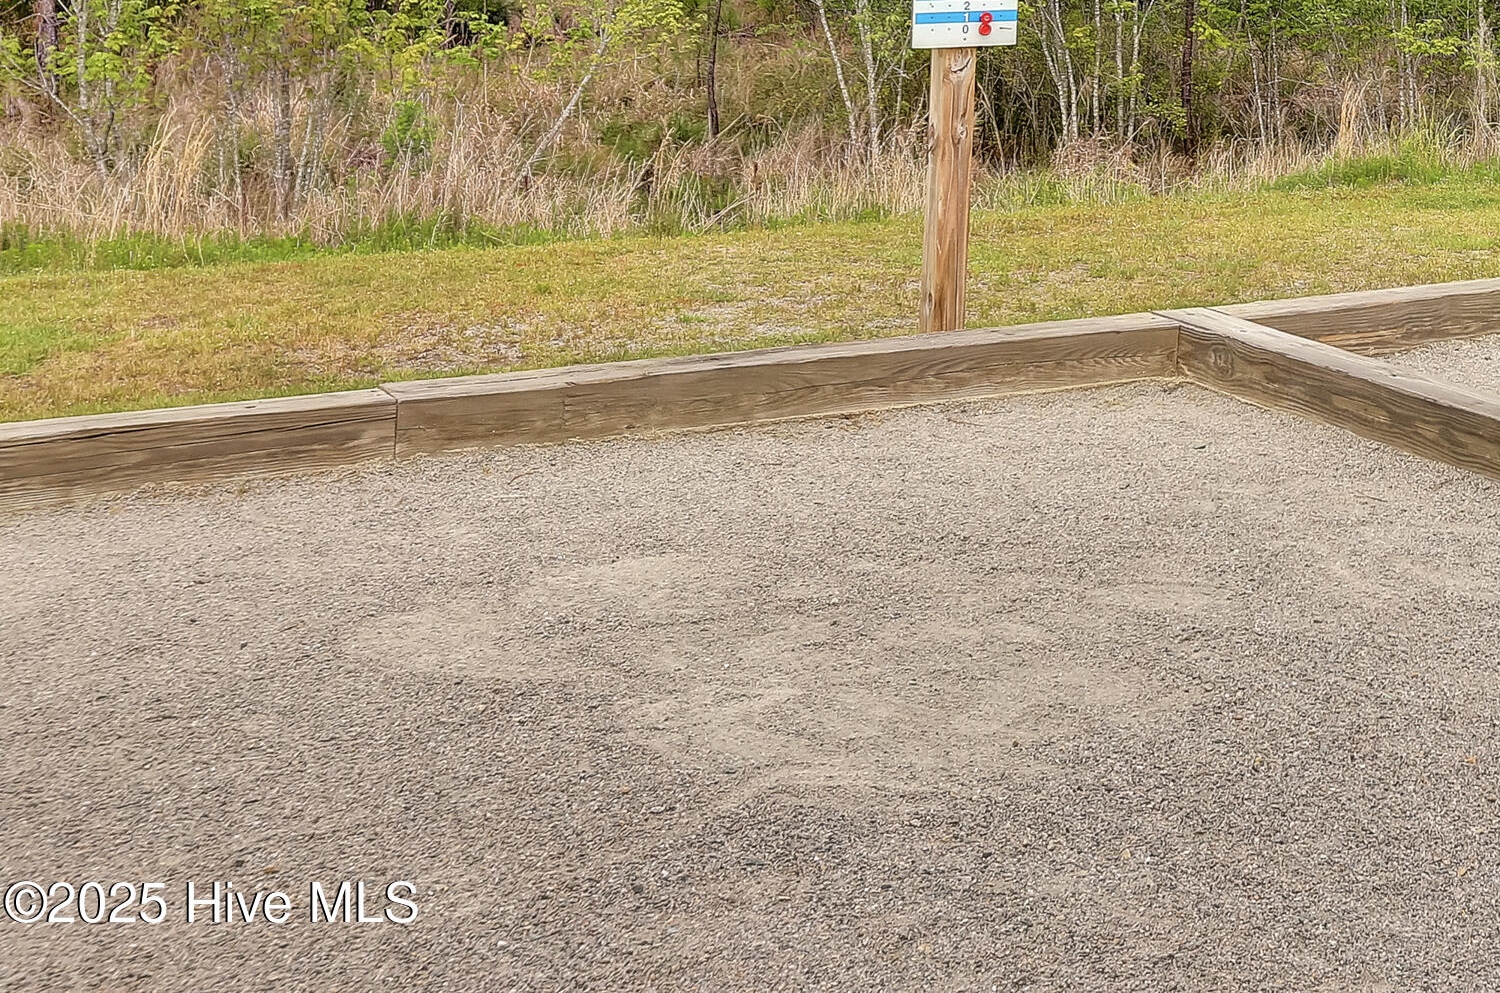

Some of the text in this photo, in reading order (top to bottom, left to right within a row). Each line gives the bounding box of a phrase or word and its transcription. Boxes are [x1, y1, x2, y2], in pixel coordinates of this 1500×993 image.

[964, 2, 970, 10] 2
[964, 13, 969, 22] 1
[962, 25, 968, 33] 0
